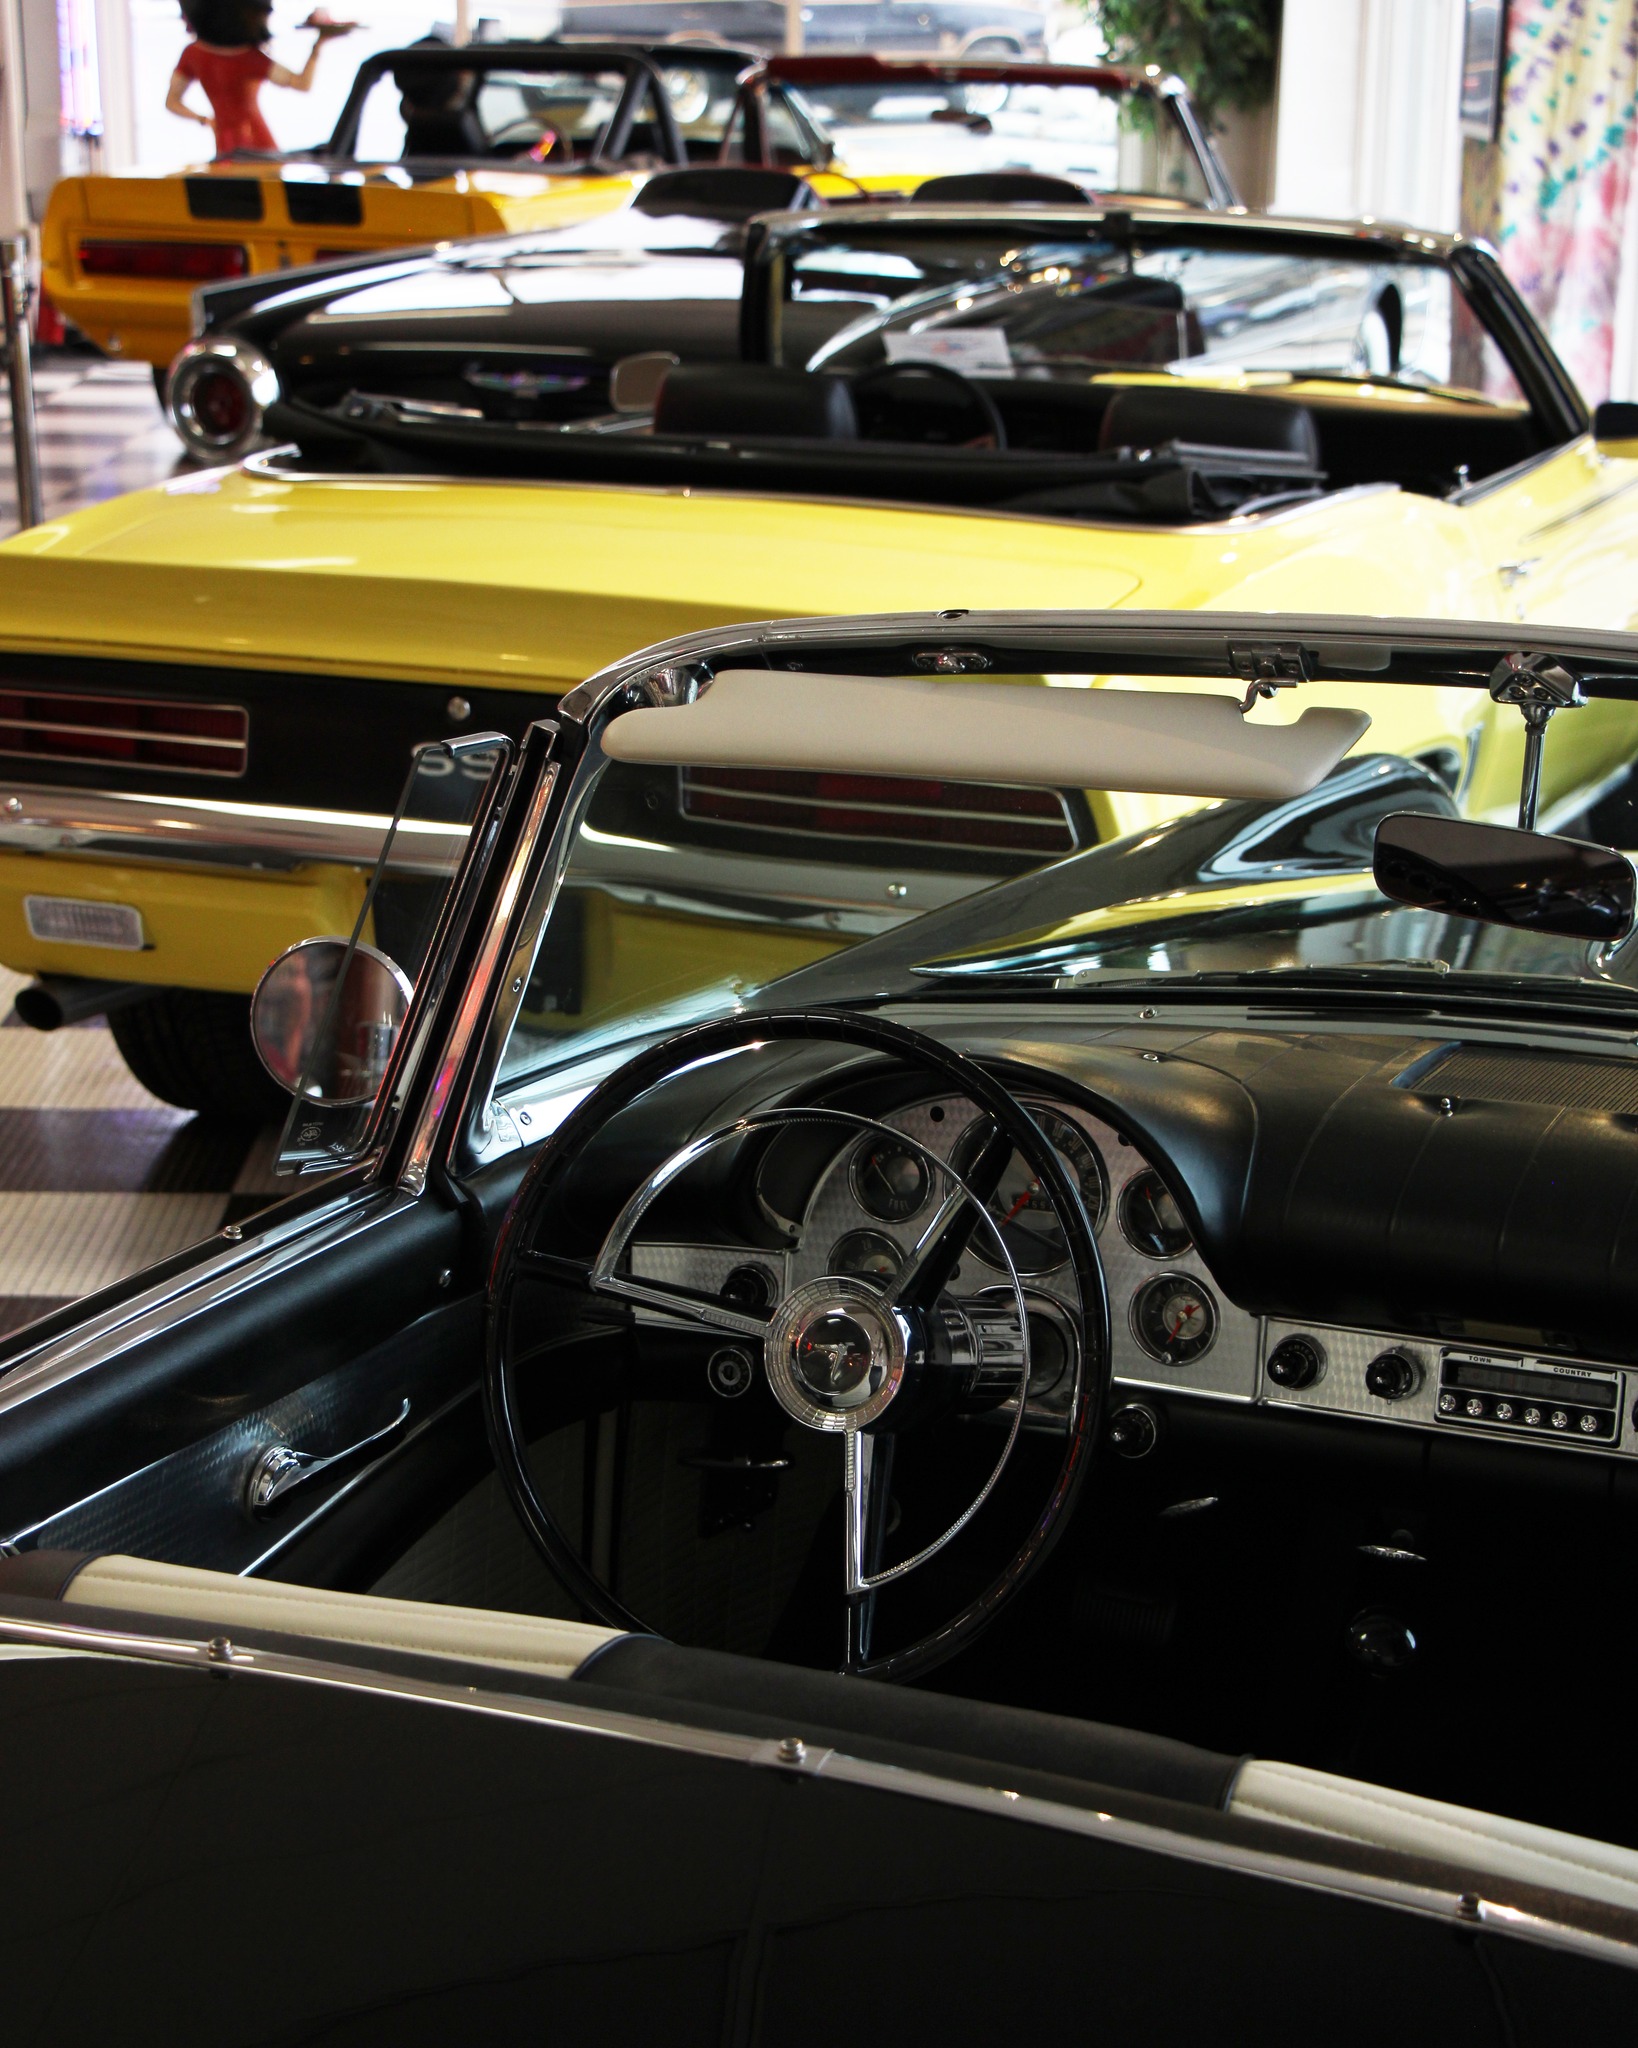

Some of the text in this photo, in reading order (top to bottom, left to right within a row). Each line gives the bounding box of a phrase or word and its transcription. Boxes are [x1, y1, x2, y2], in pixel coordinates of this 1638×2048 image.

[411, 741, 499, 781] SS
[888, 1198, 911, 1212] FUEL
[1468, 1355, 1492, 1364] TOWN
[1553, 1366, 1592, 1378] COUNTRY
